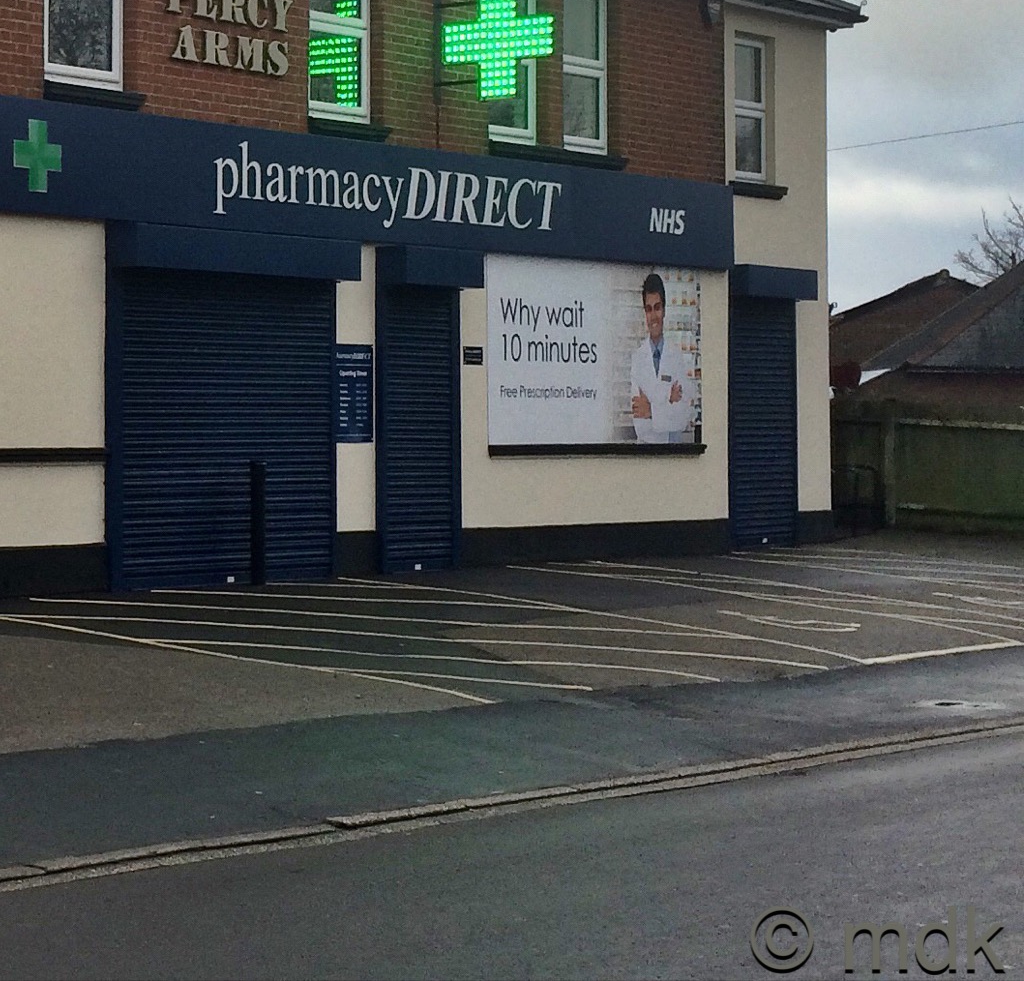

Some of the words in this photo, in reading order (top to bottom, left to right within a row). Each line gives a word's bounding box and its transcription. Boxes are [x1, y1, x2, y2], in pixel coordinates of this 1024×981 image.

[171, 24, 290, 77] ARMS
[649, 207, 686, 235] NHS
[500, 297, 541, 332] Why
[545, 300, 584, 328] wait
[502, 333, 522, 362] 10
[527, 334, 598, 364] minutes
[500, 385, 517, 398] Free
[520, 385, 564, 400] Prescription
[566, 386, 597, 400] Delivery
